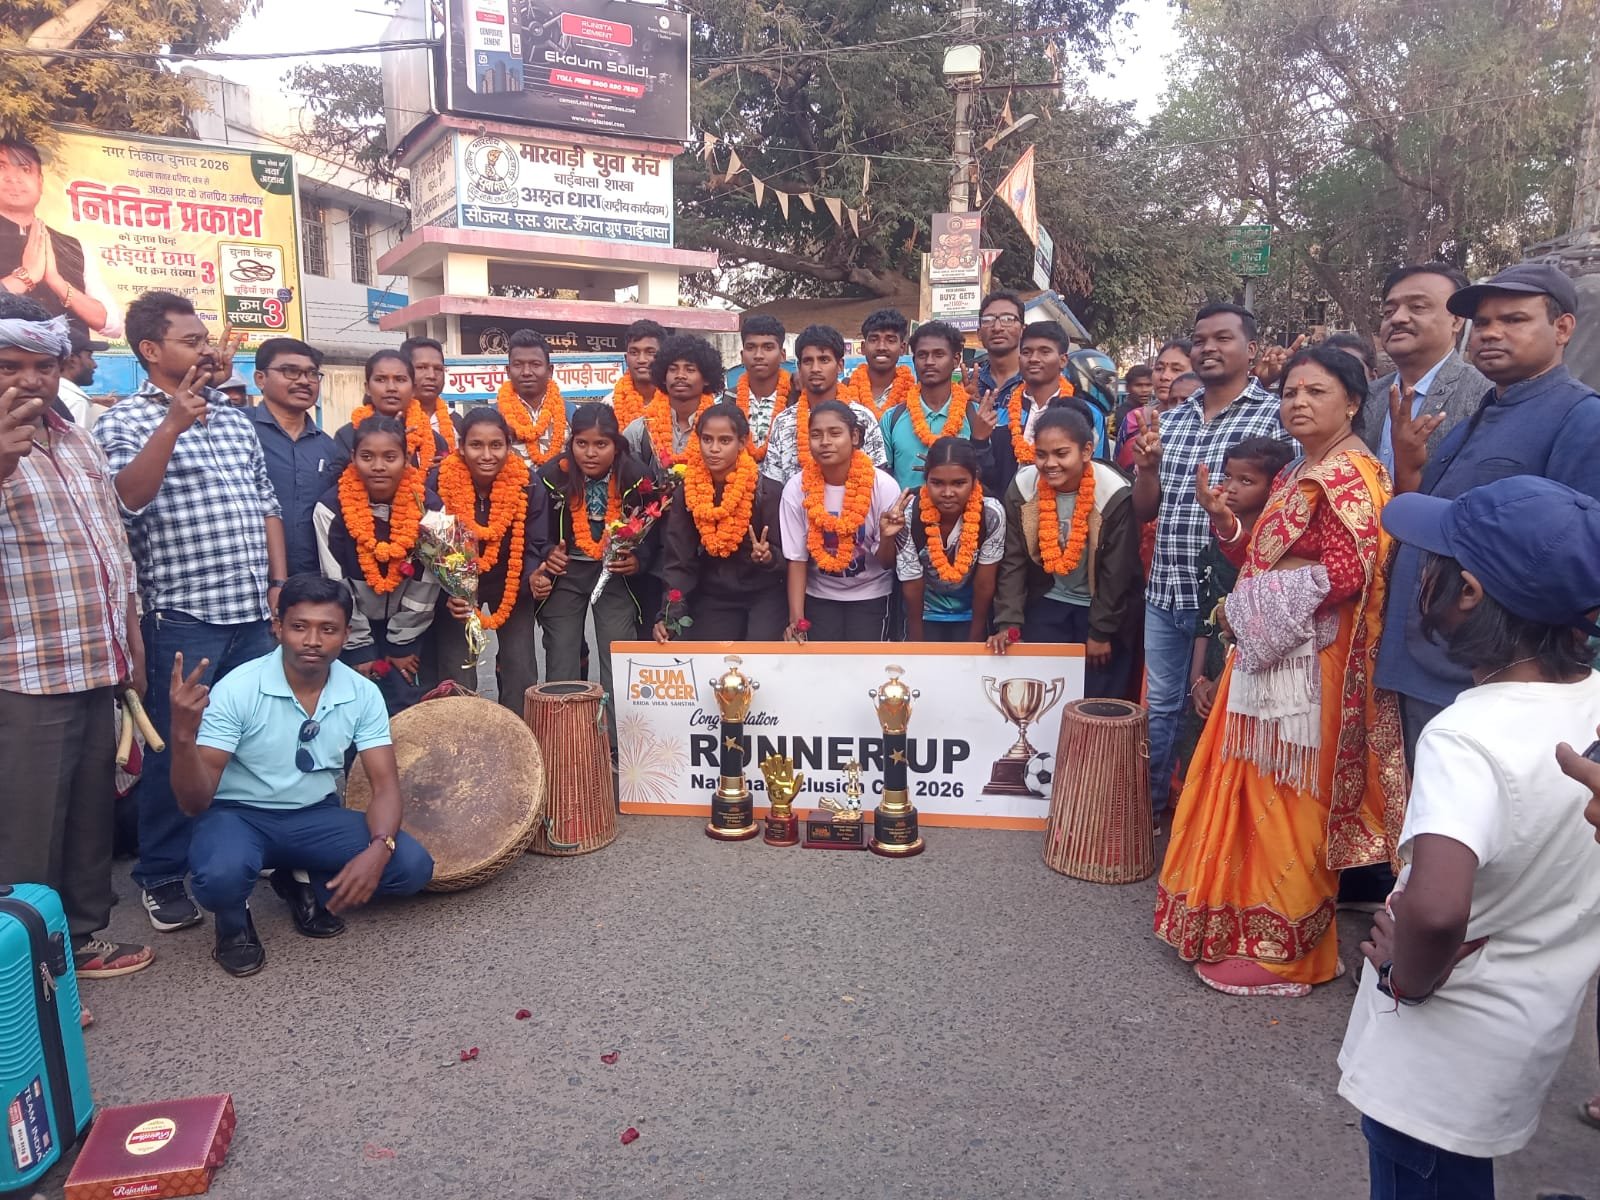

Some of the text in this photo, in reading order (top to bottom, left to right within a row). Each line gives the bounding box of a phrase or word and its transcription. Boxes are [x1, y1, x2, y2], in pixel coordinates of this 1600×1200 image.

[581, 20, 613, 31] RUNGTA
[581, 28, 613, 39] CEMENT
[544, 50, 649, 78] Ekdum Solid!
[556, 74, 573, 83] TOLL
[102, 146, 229, 171] नगर निकाय चुनाव 2026
[520, 144, 660, 177] मारवाड़ी युवा मंच
[148, 185, 173, 196] अध्यक्ष
[175, 188, 186, 197] पद
[554, 171, 634, 192] चाईबासा शाखा
[521, 187, 565, 207] अमृत
[567, 192, 602, 209] धारा
[66, 180, 262, 238] नितिन प्रकाश
[605, 221, 622, 238] ग्रुप
[623, 221, 668, 240] चाईबासा
[161, 252, 196, 266] छाप
[229, 248, 272, 259] चुनाव चिन्ह
[135, 266, 148, 274] पर
[201, 261, 216, 284] 3
[227, 308, 262, 323] संख्या
[239, 298, 284, 327] क्रम 3
[545, 331, 618, 351] वाड़ी युवा
[448, 363, 619, 393] गुपचुप पापड़ी चाट
[639, 669, 685, 685] SLUM
[631, 683, 695, 700] SOCCER
[690, 708, 779, 731] Conglation
[906, 738, 970, 774] UP
[916, 781, 964, 797] 2026
[24, 1085, 43, 1162] TEAM INDIA
[113, 1183, 158, 1196] Rajasthan
